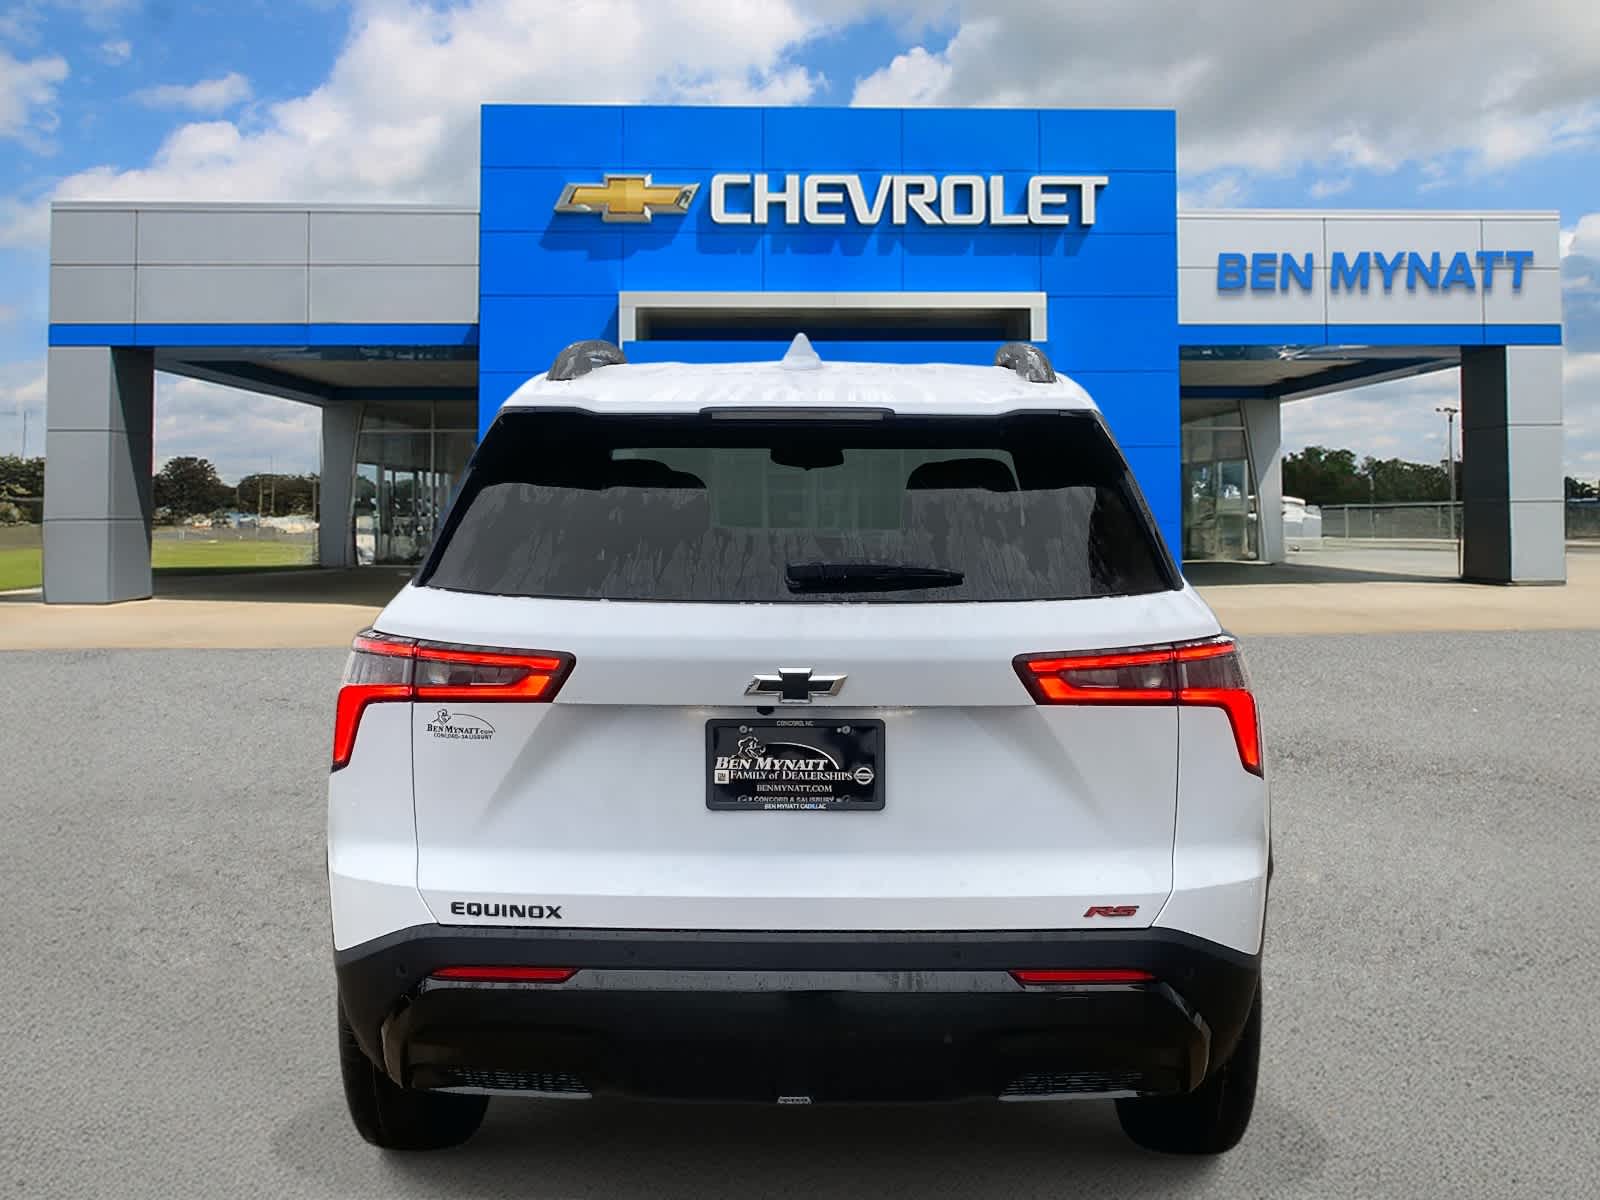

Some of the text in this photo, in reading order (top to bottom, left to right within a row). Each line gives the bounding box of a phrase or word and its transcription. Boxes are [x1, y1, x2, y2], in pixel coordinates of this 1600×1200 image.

[710, 173, 1109, 226] CHEVROLET
[1217, 250, 1534, 291] BEN MYNATT
[714, 756, 829, 771] BEN MYNATT
[730, 770, 768, 780] FAMILY
[769, 771, 780, 780] of
[782, 770, 853, 781] DEALERSHIPS
[756, 784, 832, 792] BENMYNATT.COM
[450, 901, 562, 919] EQUINOX
[1083, 905, 1139, 918] RS
